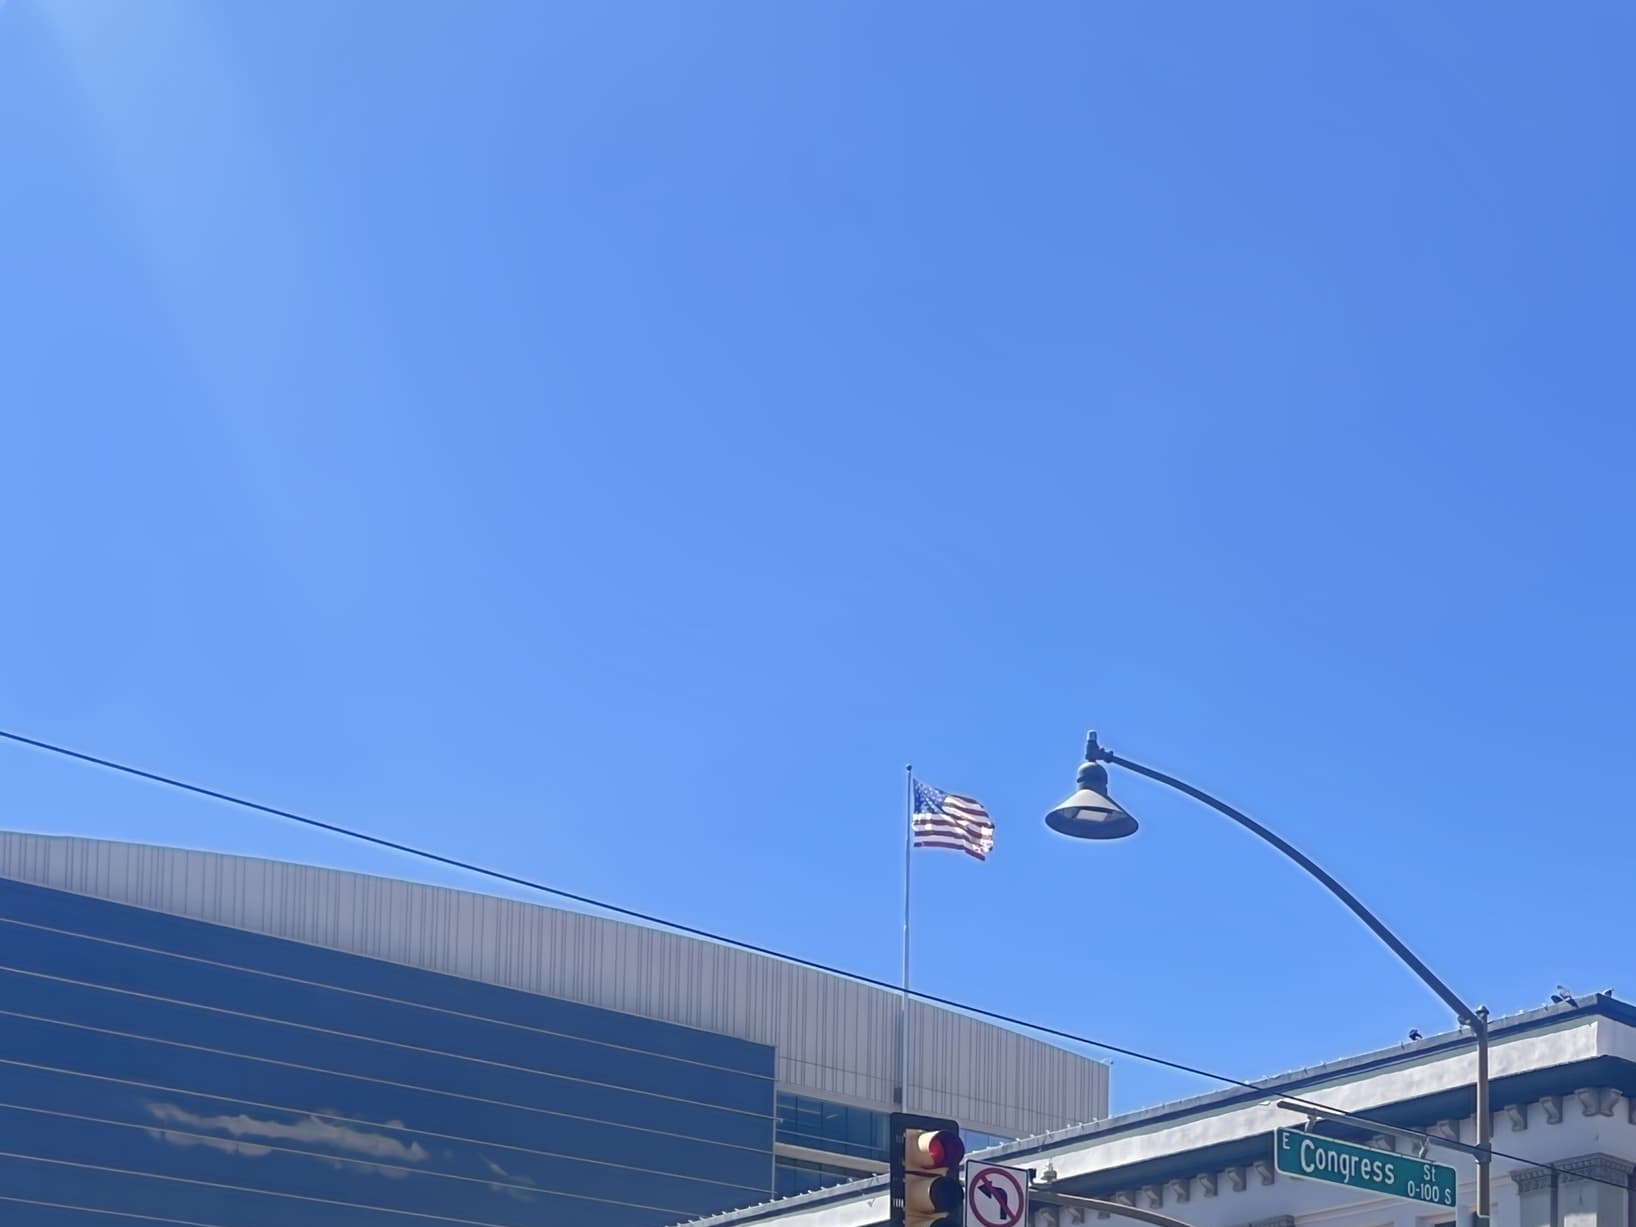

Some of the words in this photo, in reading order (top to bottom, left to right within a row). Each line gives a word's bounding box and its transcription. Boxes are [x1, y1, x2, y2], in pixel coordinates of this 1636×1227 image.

[1282, 1132, 1290, 1150] E
[1300, 1139, 1395, 1184] Congress
[1423, 1164, 1436, 1182] St
[1407, 1180, 1439, 1202] 0-100
[1444, 1188, 1452, 1205] S
